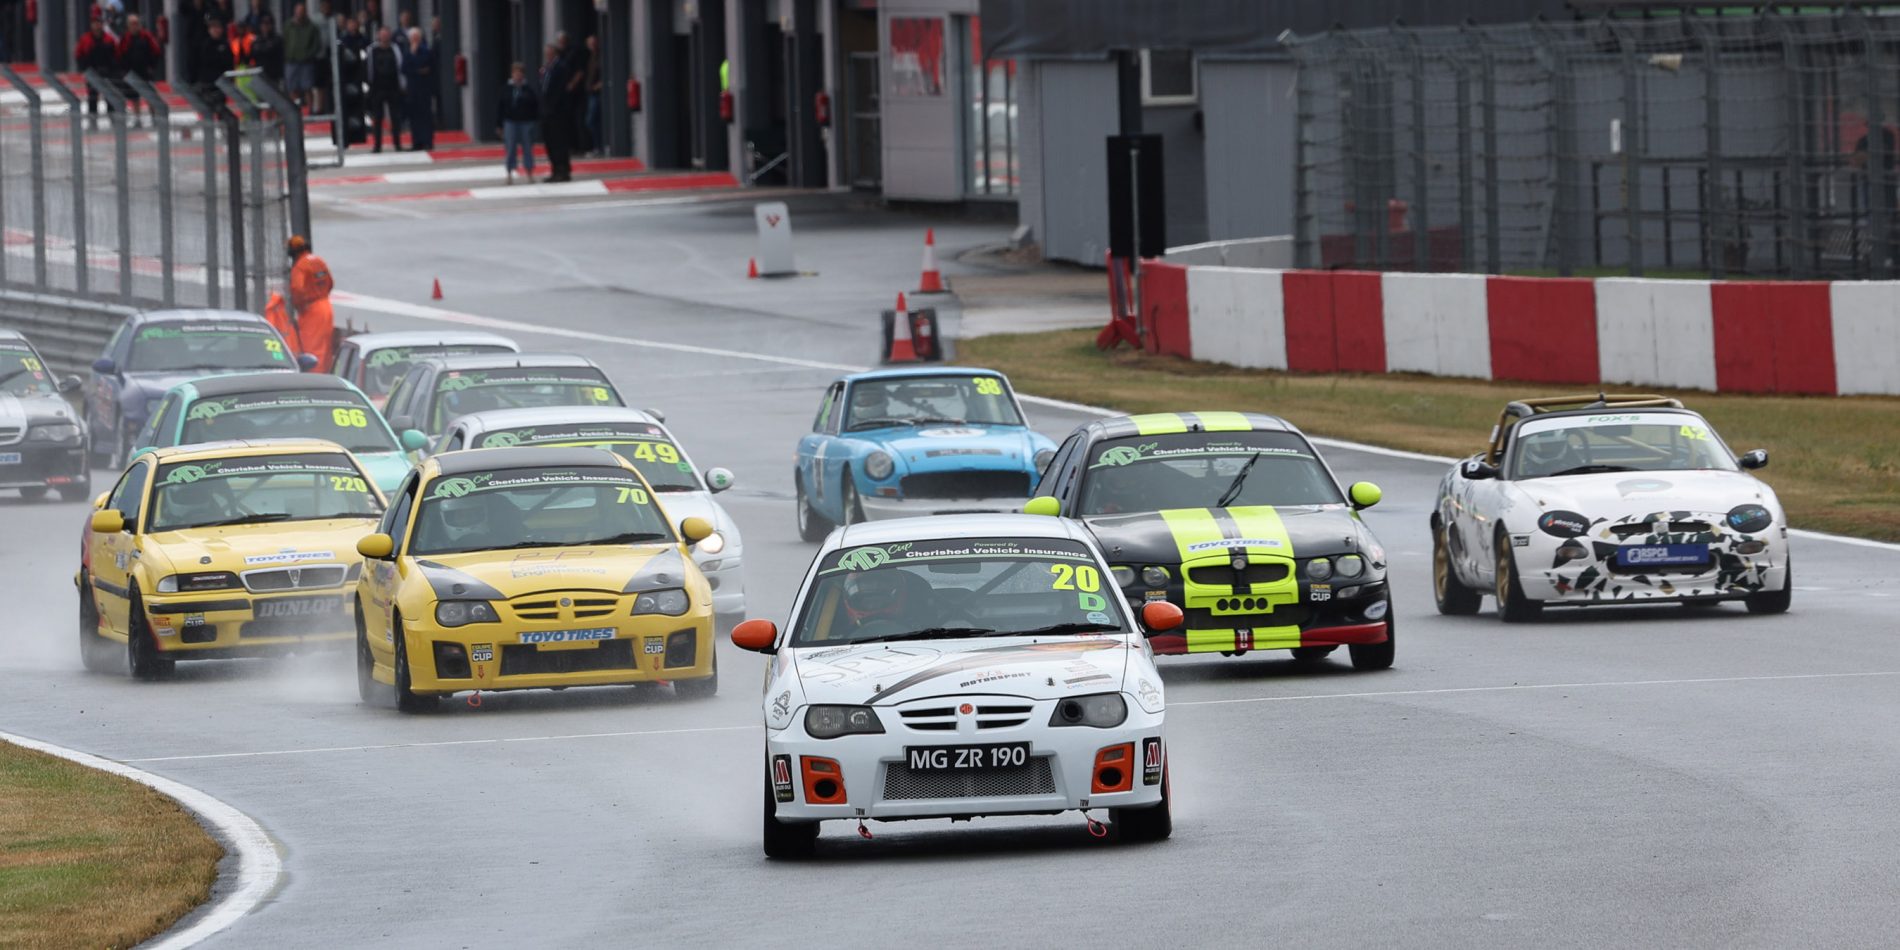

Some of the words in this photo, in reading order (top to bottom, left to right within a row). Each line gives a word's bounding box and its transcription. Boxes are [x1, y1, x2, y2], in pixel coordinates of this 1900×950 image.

[972, 377, 1002, 396] 38
[234, 399, 277, 410] Cherished
[332, 408, 367, 428] 66
[1587, 415, 1641, 423] FOX'S
[531, 431, 578, 441] Cherished
[1679, 425, 1707, 440] 42
[1138, 442, 1158, 453] Cup
[1153, 447, 1205, 456] Cherished
[634, 442, 680, 465] 49
[217, 465, 266, 474] Cherished
[472, 473, 493, 484] Cup
[489, 477, 540, 487] Cherished
[330, 476, 369, 493] 220
[615, 487, 649, 505] 70
[1190, 541, 1231, 551] TOYO
[838, 546, 890, 571] MG
[888, 542, 914, 555] Cup
[905, 547, 970, 558] Cherished
[972, 547, 1021, 555] Vehicle
[1023, 547, 1088, 558] Insurance
[247, 555, 288, 563] TOYO
[1051, 564, 1100, 593] 20
[1078, 592, 1107, 612] D
[1310, 593, 1331, 601] CUP
[259, 599, 339, 618] DUNLOP
[522, 630, 566, 643] TOYO
[567, 628, 614, 640] TIRES
[645, 645, 664, 654] CUP
[472, 652, 493, 662] CUP
[960, 672, 1032, 688] MOTORSPORT
[911, 749, 948, 769] MG
[954, 748, 984, 768] ZR
[991, 746, 1026, 767] 190
